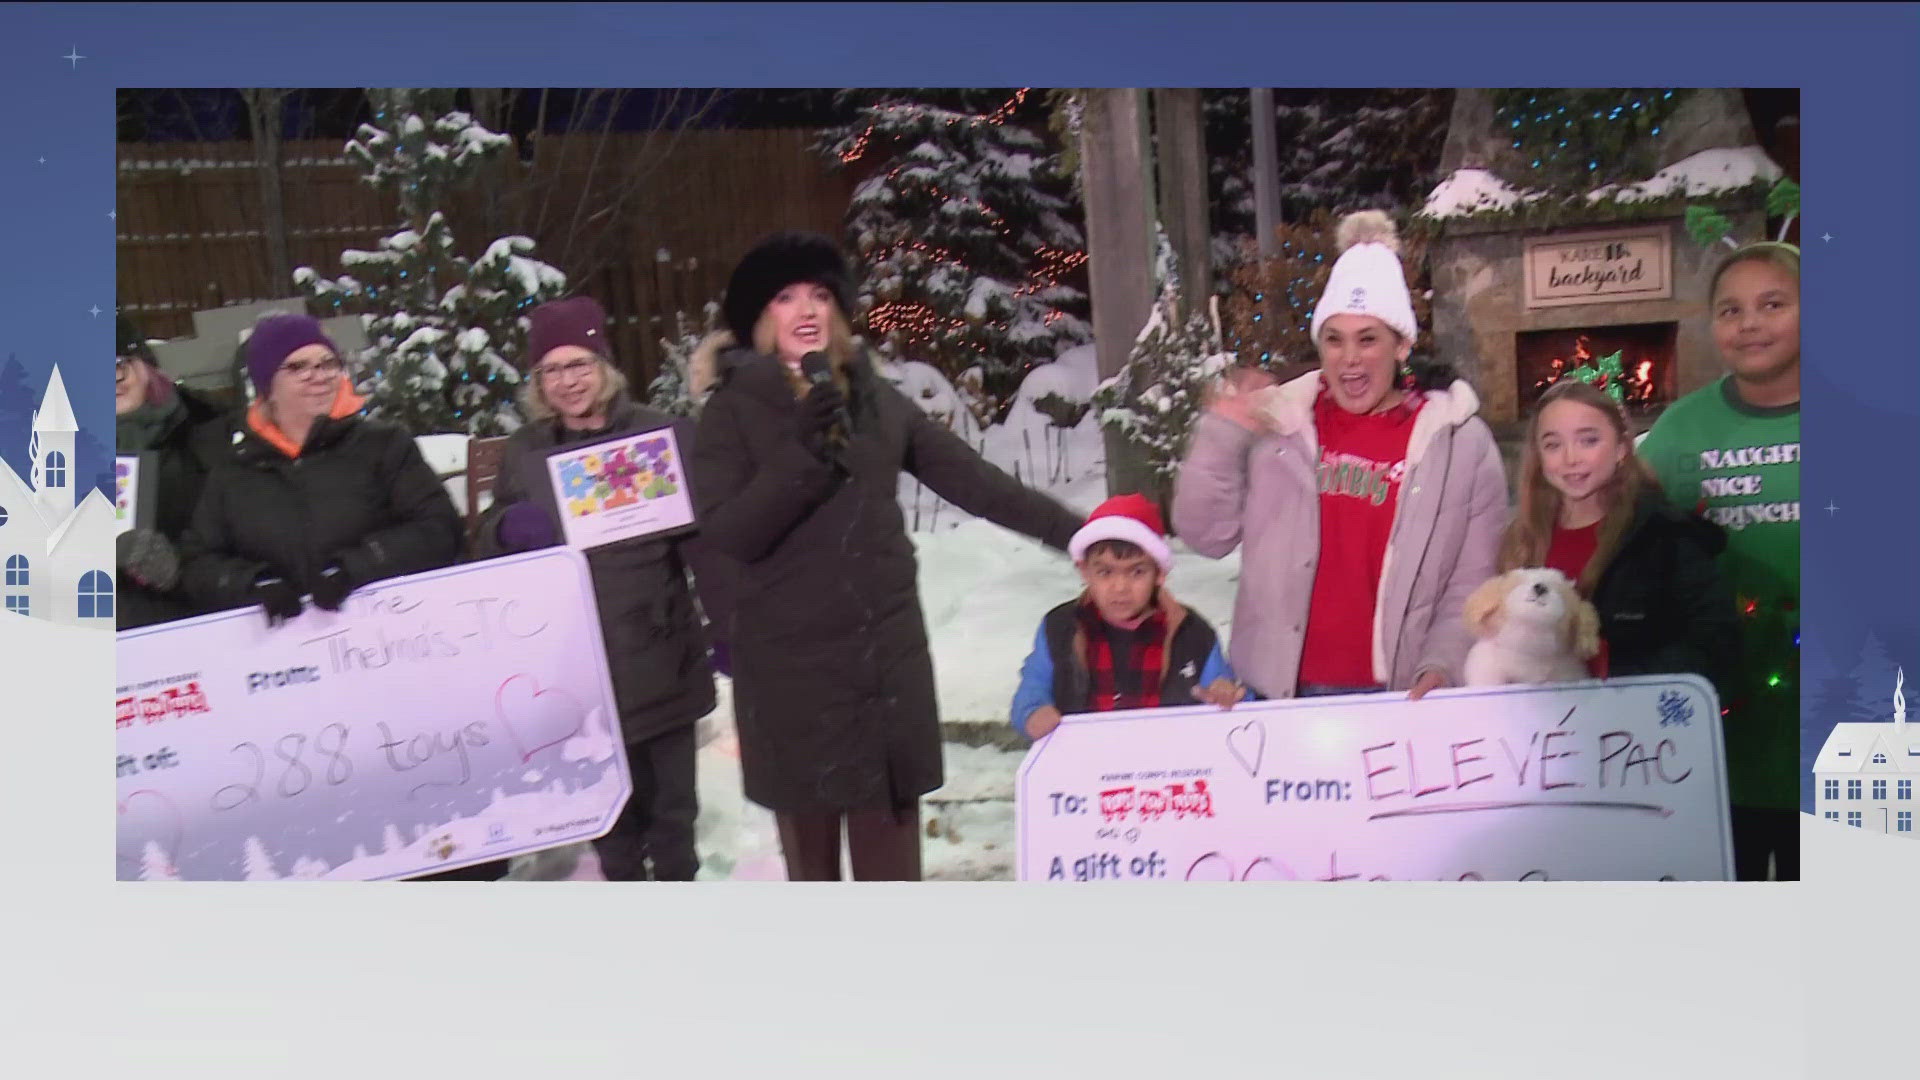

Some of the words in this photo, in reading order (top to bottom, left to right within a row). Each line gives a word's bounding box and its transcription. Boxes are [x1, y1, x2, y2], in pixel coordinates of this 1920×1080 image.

[1549, 258, 1644, 292] backyard
[1701, 475, 1762, 498] NICE
[209, 722, 353, 812] 288
[376, 716, 490, 799] toys
[1599, 730, 1693, 789] PAC
[1050, 792, 1088, 816] To:
[1266, 778, 1352, 805] From:
[1049, 857, 1065, 881] A
[1073, 851, 1121, 881] gift
[1130, 851, 1167, 879] of:
